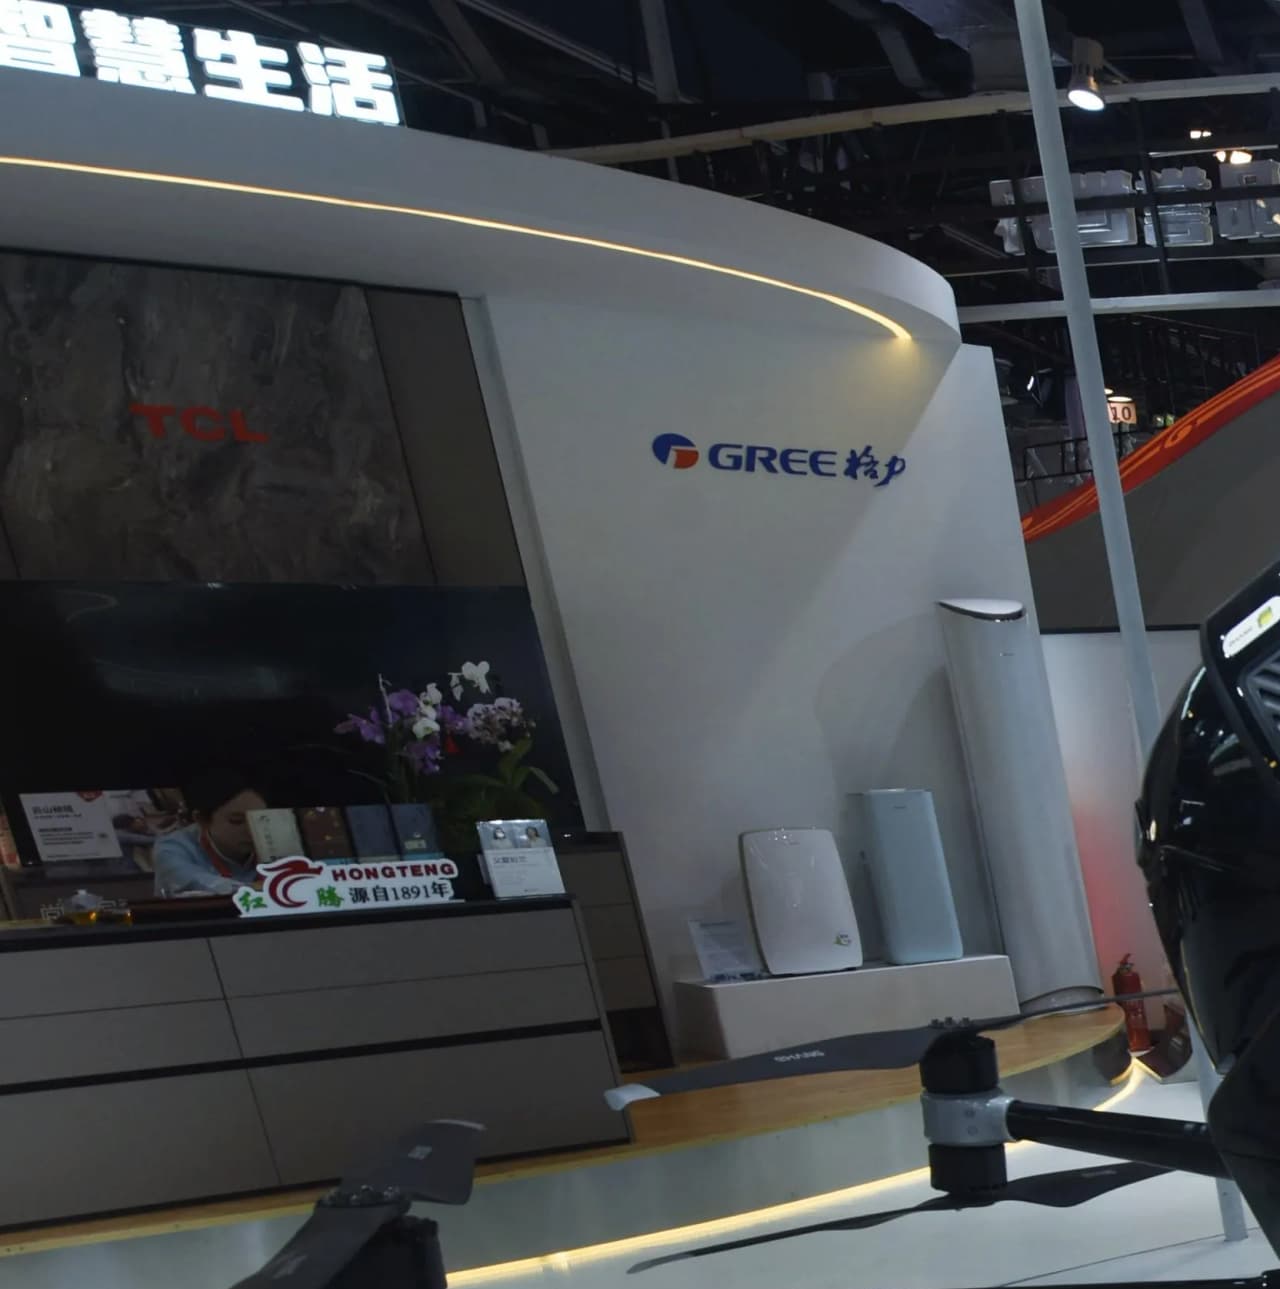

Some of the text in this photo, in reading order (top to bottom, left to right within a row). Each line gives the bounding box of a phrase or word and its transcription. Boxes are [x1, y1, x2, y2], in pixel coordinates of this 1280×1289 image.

[128, 403, 271, 443] TCL
[707, 442, 838, 478] GREE
[331, 862, 456, 882] HONGTENG
[349, 880, 450, 905] 源自1891年
